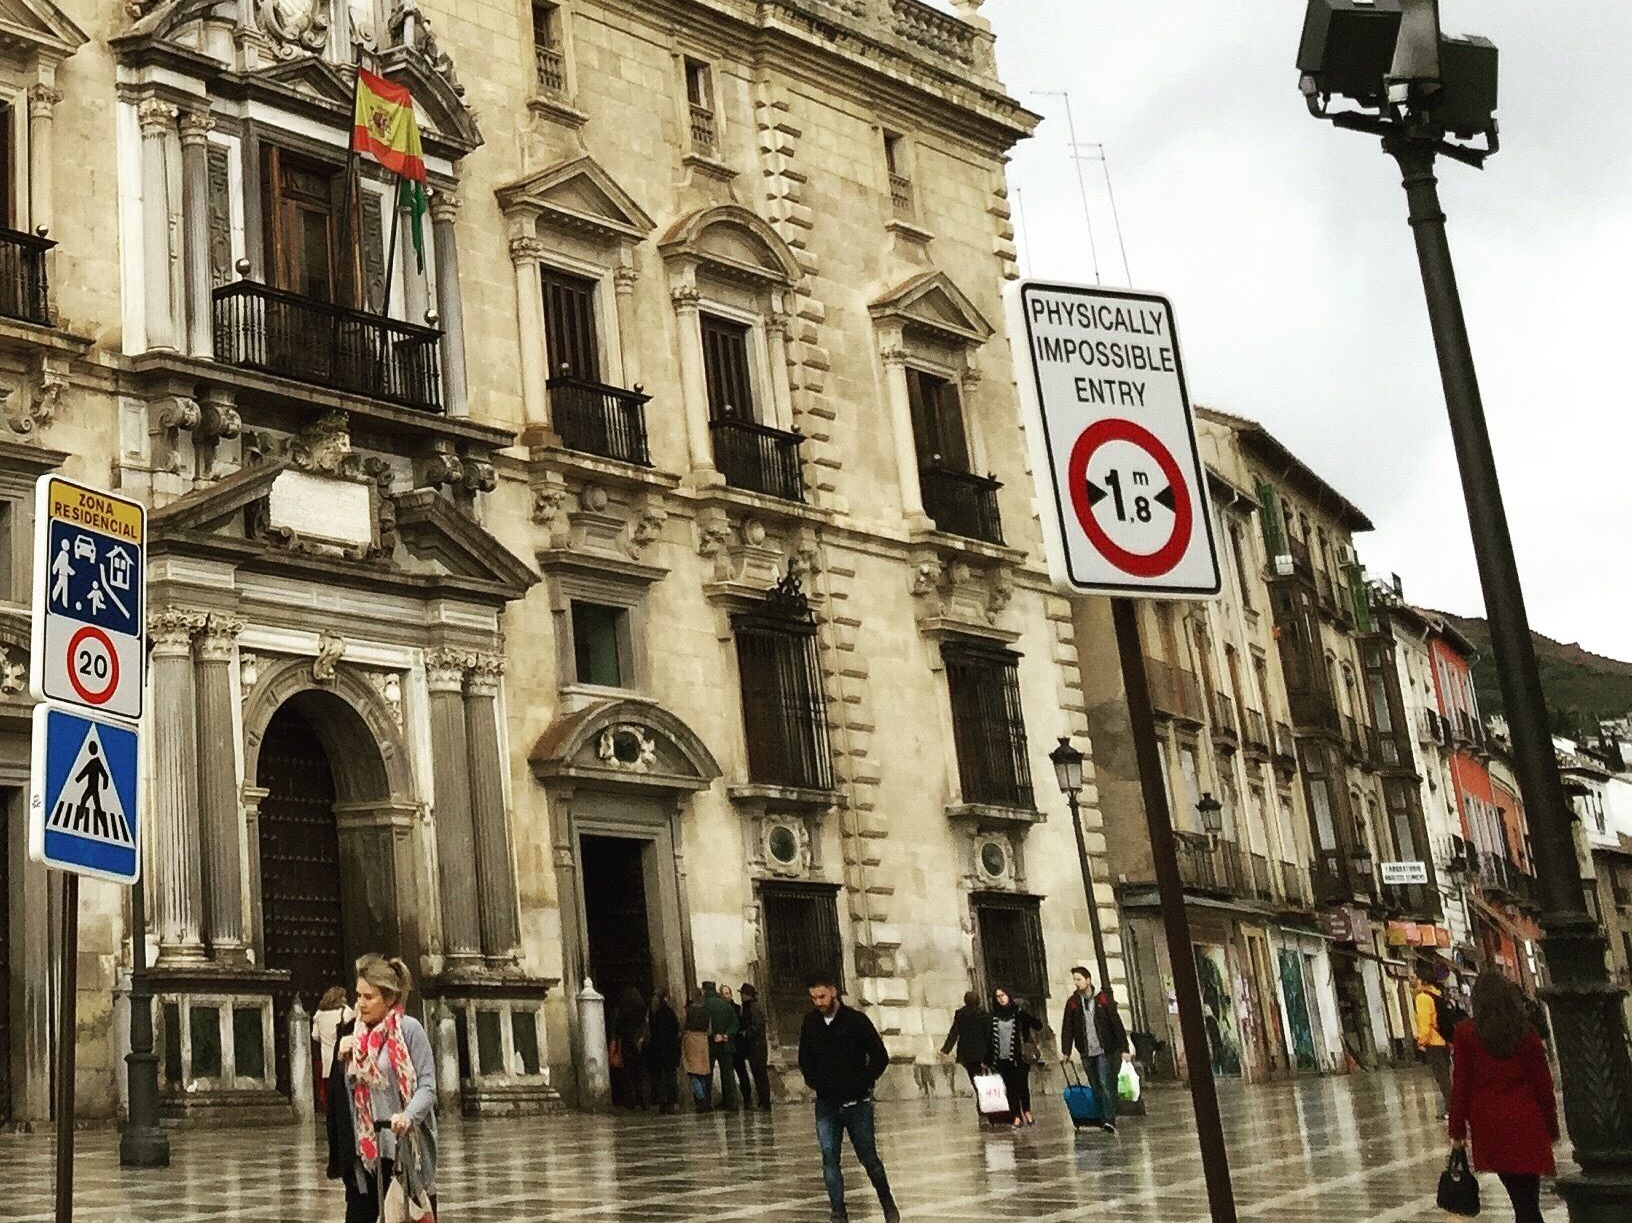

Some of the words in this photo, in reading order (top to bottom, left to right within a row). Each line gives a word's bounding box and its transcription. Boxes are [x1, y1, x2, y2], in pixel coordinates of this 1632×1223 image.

[1031, 298, 1162, 336] PHYSICALLY
[1036, 335, 1174, 372] IMPOSSIBLE
[1074, 377, 1145, 407] ENTRY
[1132, 471, 1149, 486] m
[79, 493, 114, 517] ZONA
[54, 501, 137, 540] RESIDENCIAL
[79, 650, 108, 679] 20
